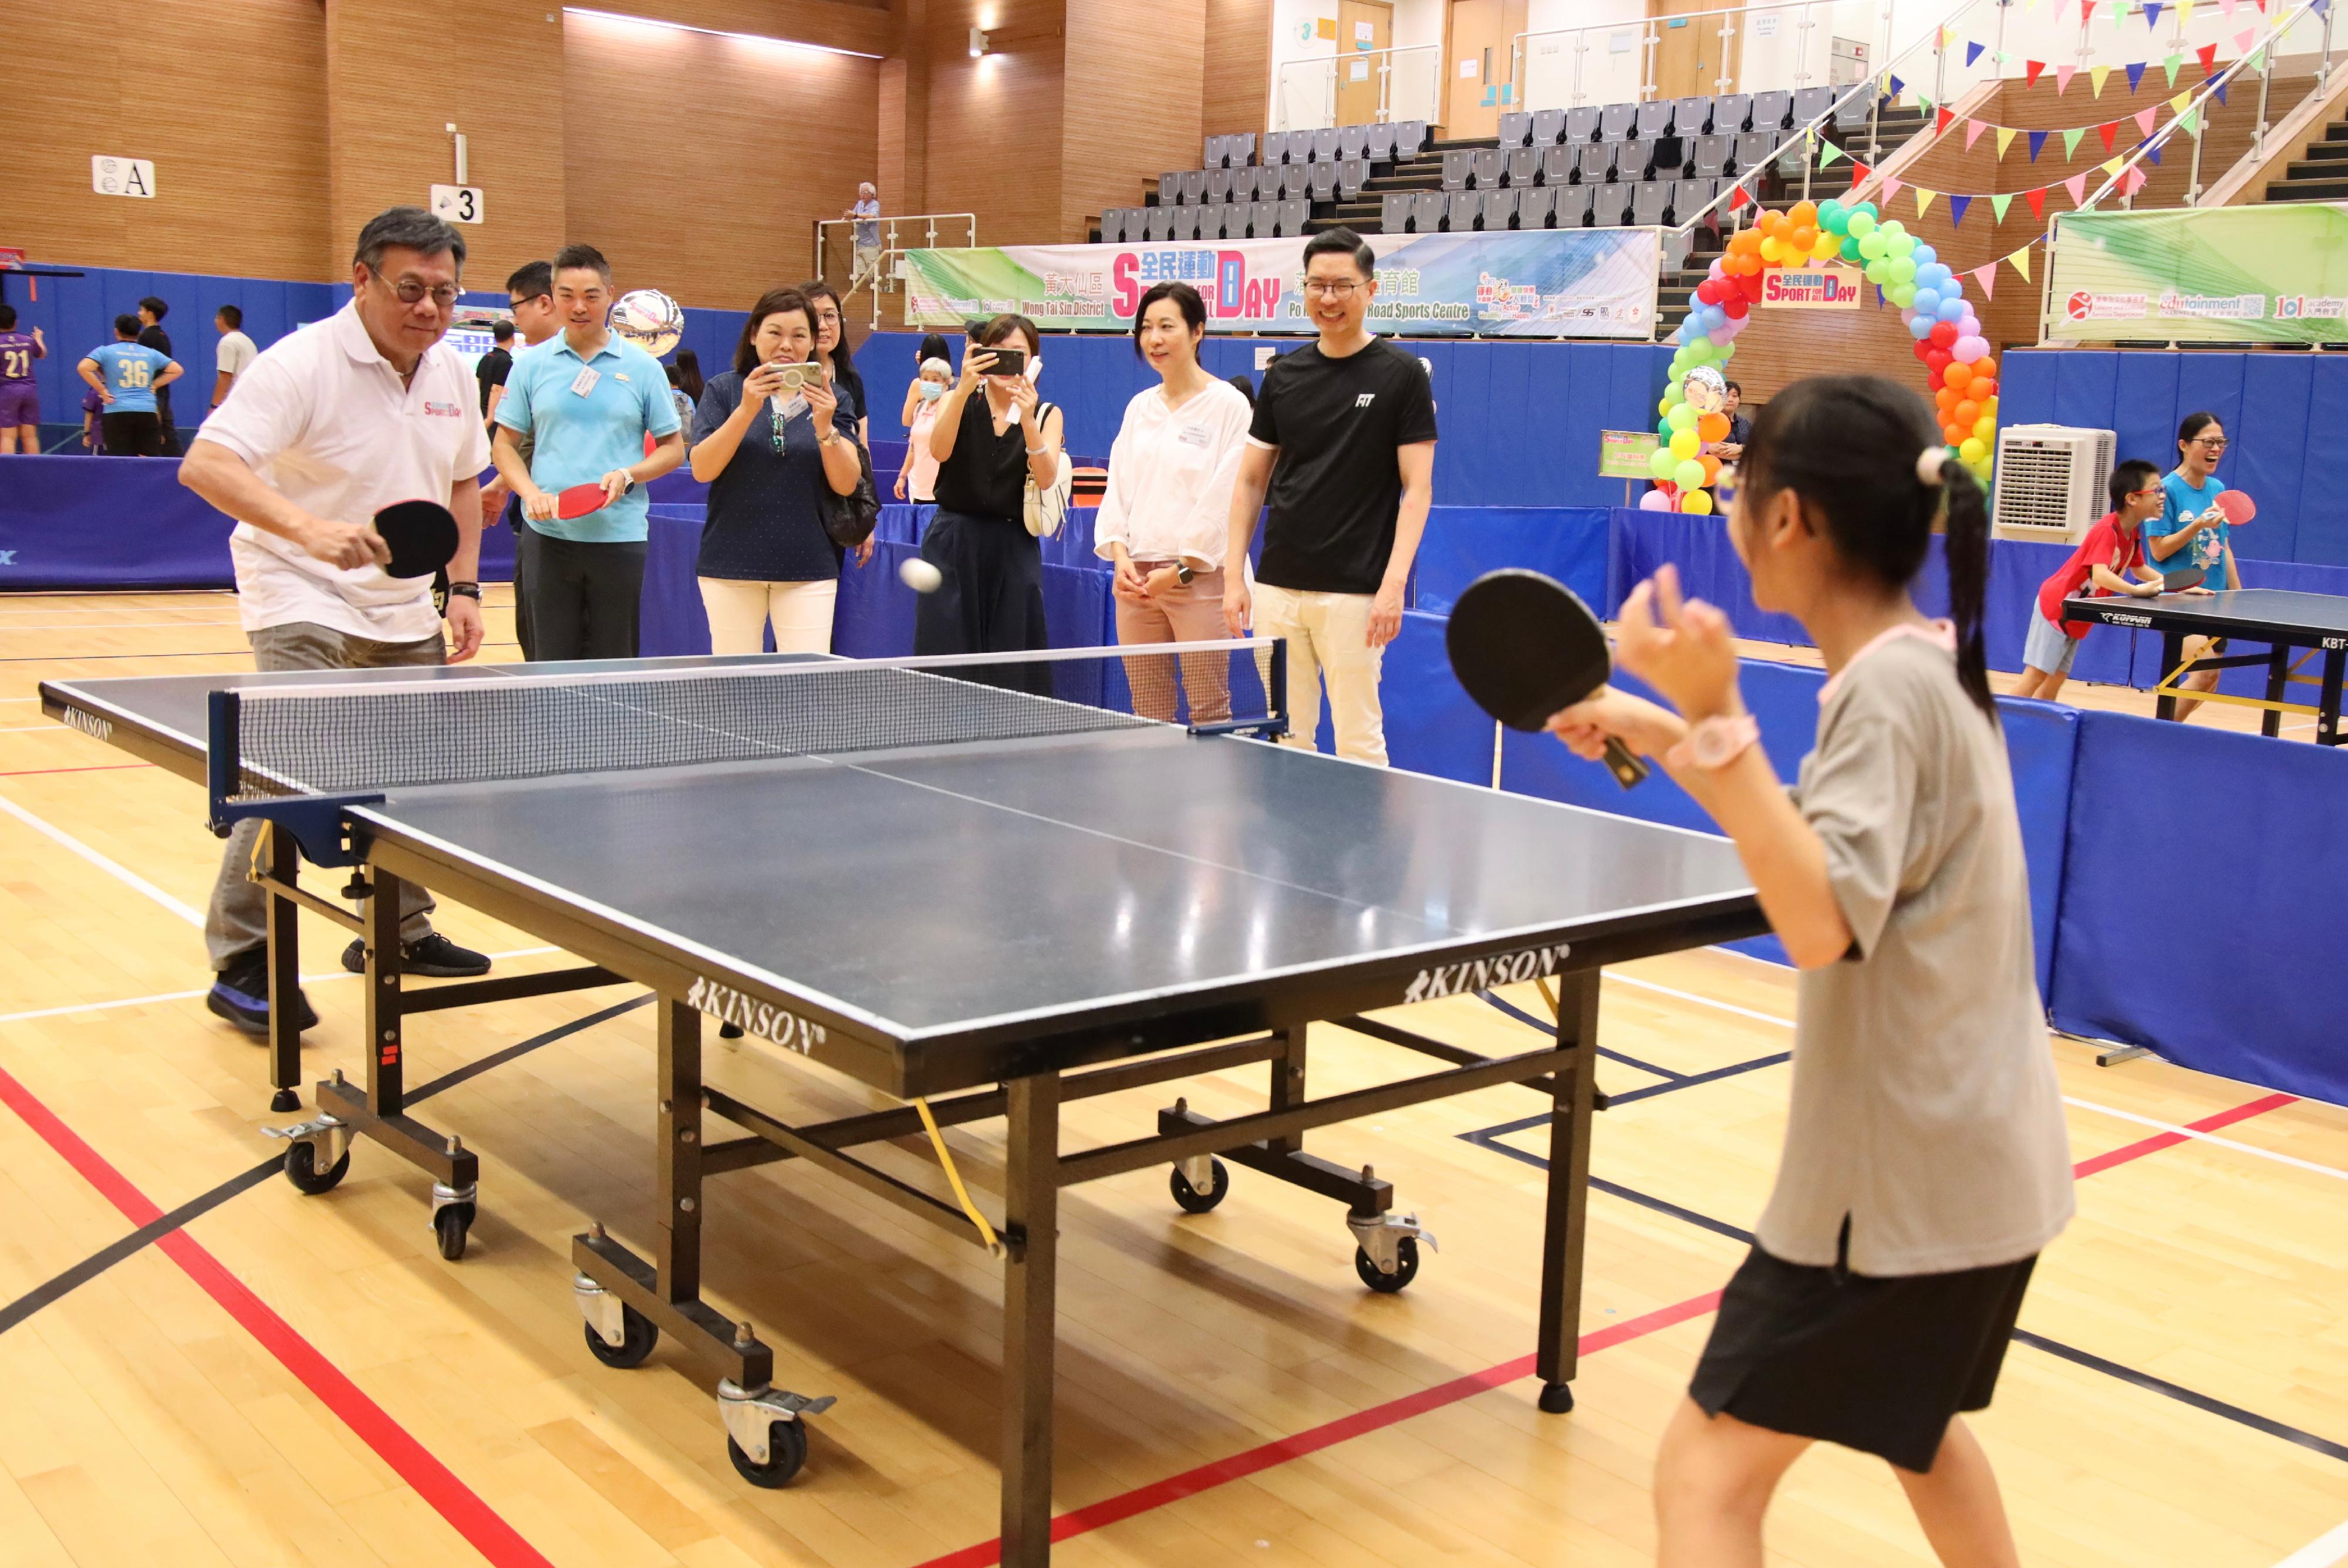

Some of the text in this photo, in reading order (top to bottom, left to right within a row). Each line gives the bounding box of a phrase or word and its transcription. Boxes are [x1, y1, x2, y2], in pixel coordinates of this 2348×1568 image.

[1301, 22, 1311, 41] 3
[123, 162, 148, 195] A
[460, 190, 474, 221] 3
[1141, 250, 1216, 280] 全民運動
[1044, 272, 1103, 295] 黃大仙區
[1216, 251, 1280, 318] DAY
[1477, 286, 1493, 296] 運動
[1766, 274, 1856, 302] SPORT DAY
[1783, 274, 1823, 286] 全民運動
[1022, 301, 1104, 316] Wong Tai Sin District
[1289, 303, 1300, 316] Po
[1367, 303, 1393, 318] Road
[1399, 302, 1430, 320] Sports
[1431, 305, 1469, 319] Centre
[1488, 304, 1502, 313] Stay
[2160, 295, 2241, 309] edutainment
[2307, 299, 2344, 308] academy
[5, 350, 29, 378] 21
[119, 359, 149, 388] 36
[70, 706, 109, 743] KINSON
[1426, 946, 1561, 998] KINSON
[703, 980, 819, 1056] KINSON
